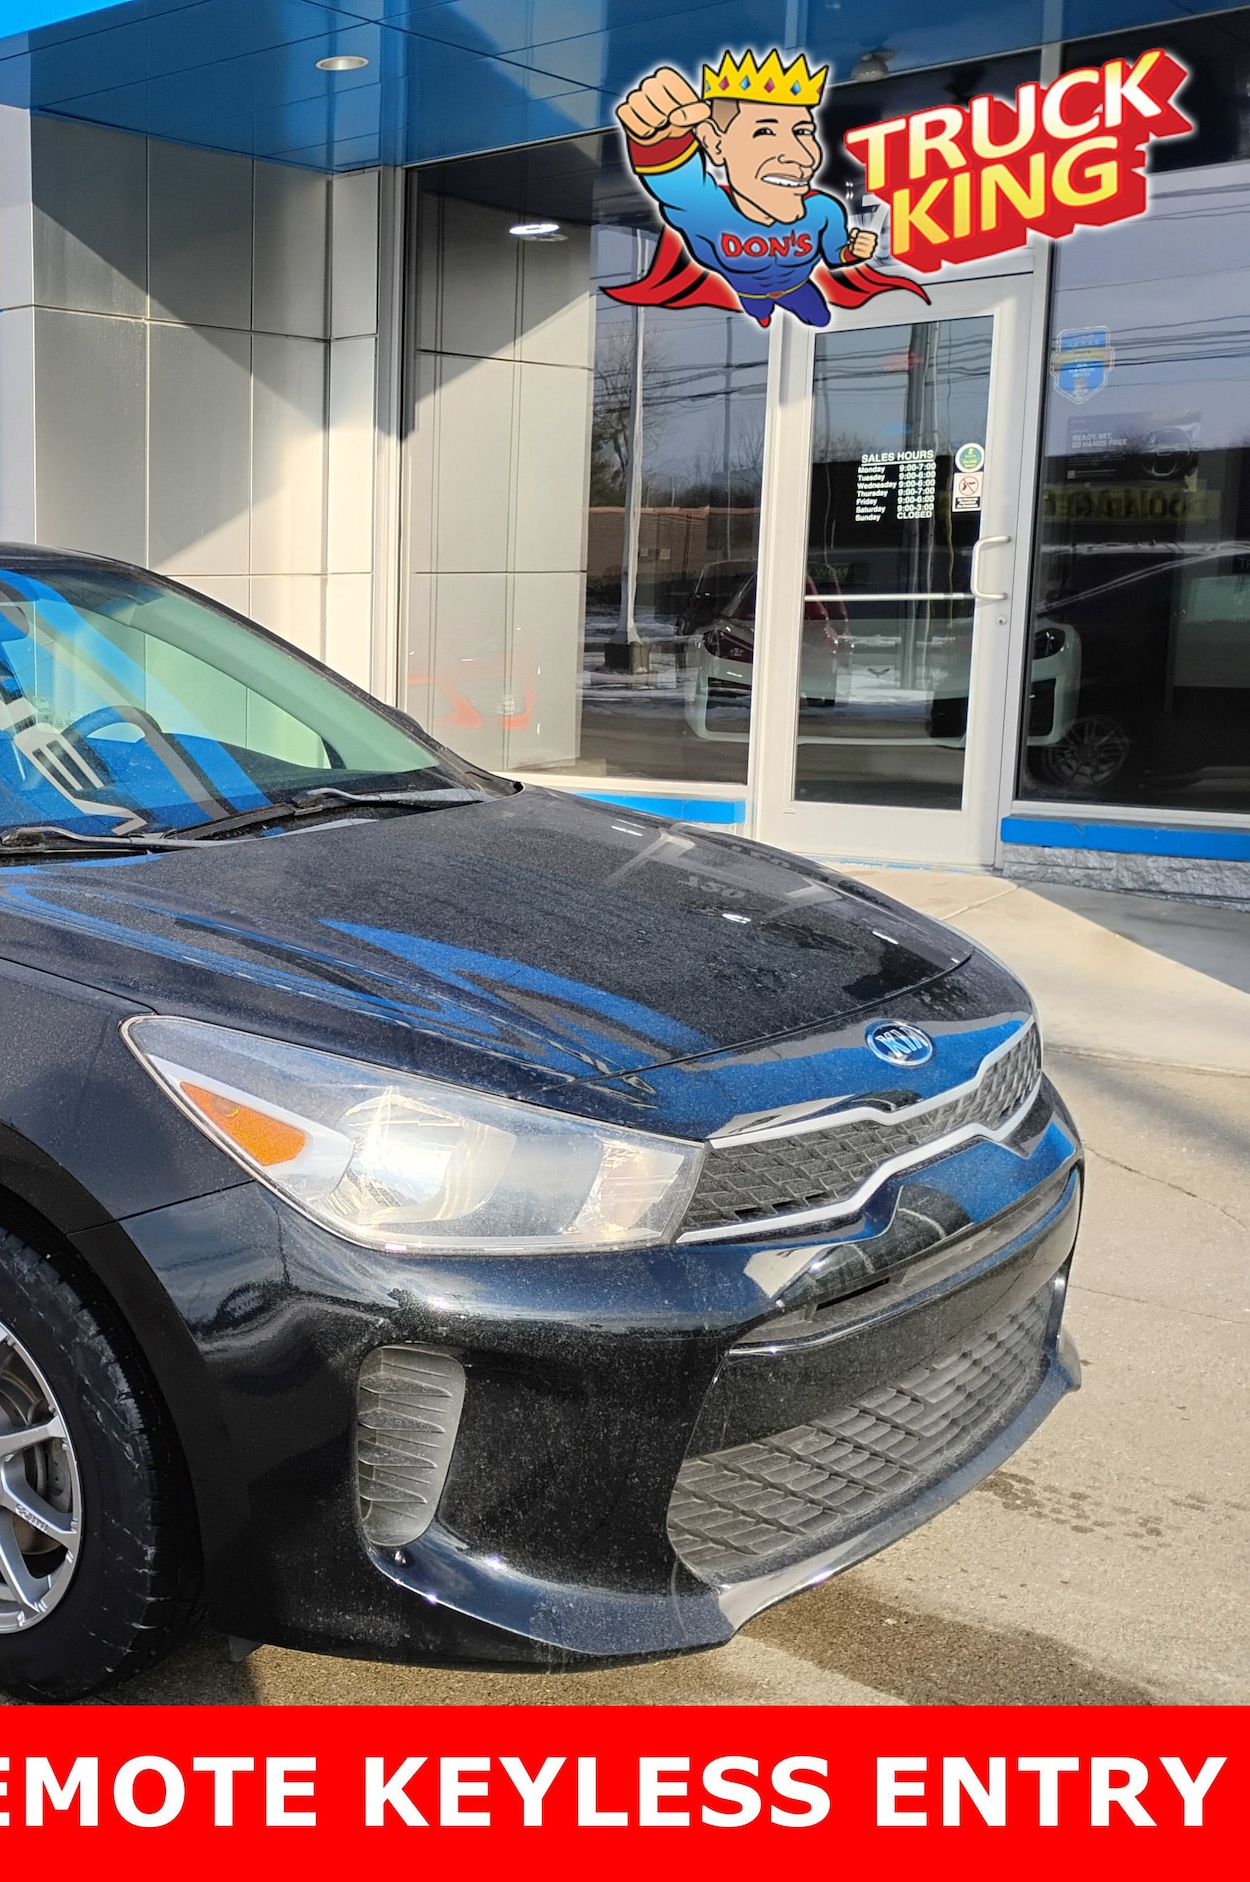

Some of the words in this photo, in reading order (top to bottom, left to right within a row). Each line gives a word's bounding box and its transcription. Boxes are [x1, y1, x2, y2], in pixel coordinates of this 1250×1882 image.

[861, 452, 896, 464] SALES
[897, 450, 935, 461] HOURS
[857, 466, 886, 474] Monday
[898, 462, 936, 472] 9:00-7:00
[857, 474, 886, 482] Tuesday
[856, 481, 898, 490] Wednesday
[856, 490, 889, 498] Thursday
[855, 498, 878, 506] Friday
[855, 506, 887, 514] Saturday
[854, 514, 882, 522] Sunday
[896, 511, 933, 519] CLOSED
